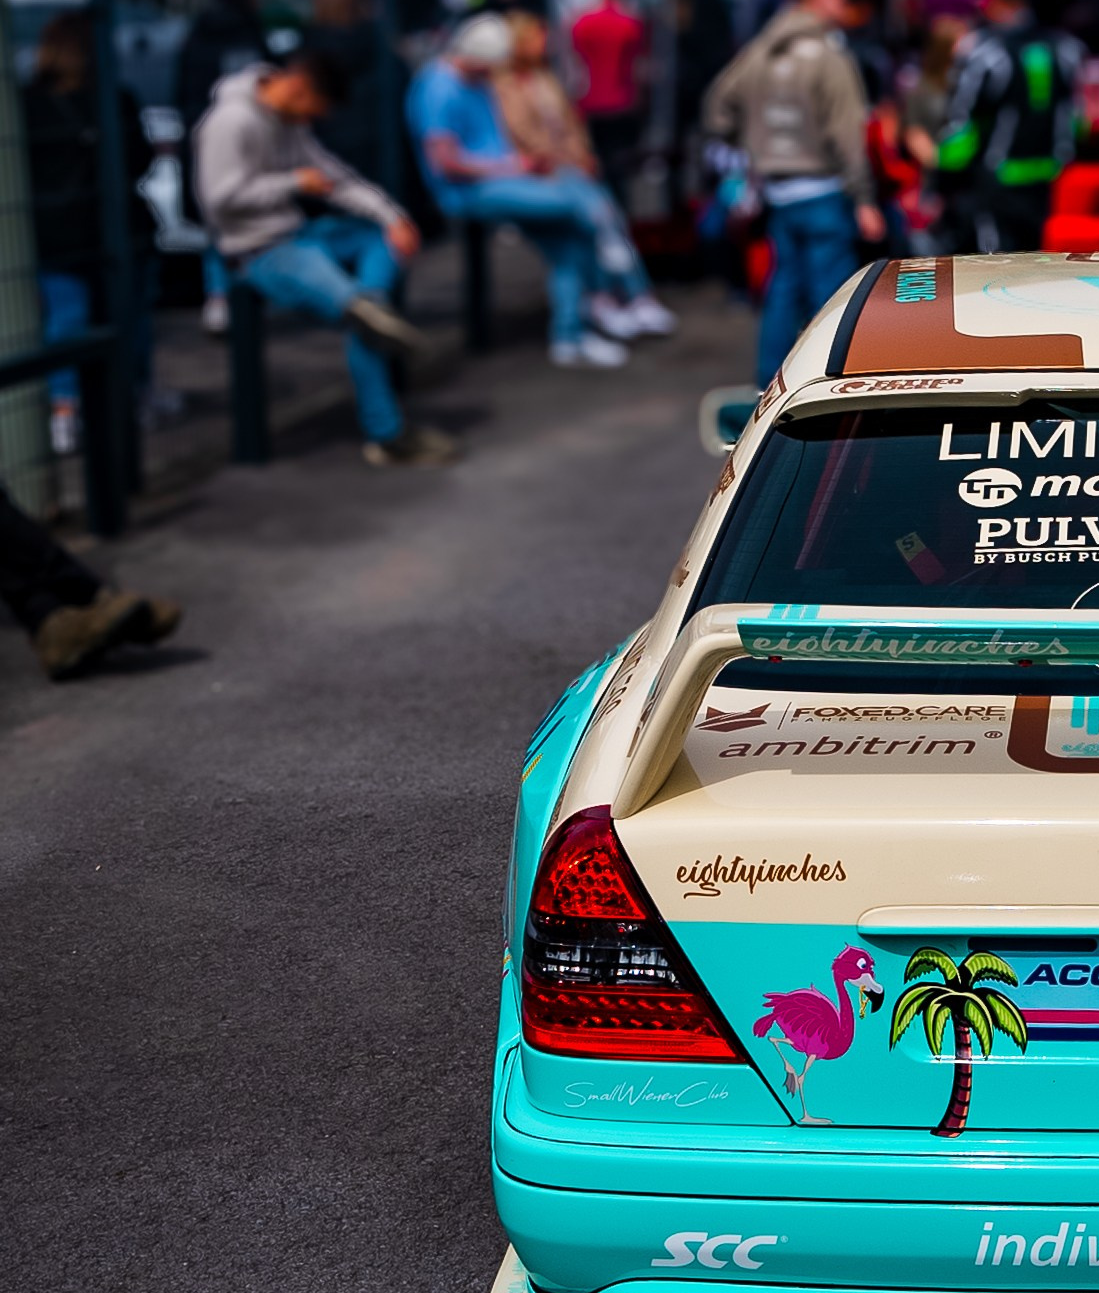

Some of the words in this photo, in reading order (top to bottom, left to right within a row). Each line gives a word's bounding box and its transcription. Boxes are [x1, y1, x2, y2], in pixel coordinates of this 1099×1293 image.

[974, 553, 999, 564] BY
[1004, 552, 1071, 563] BUSCH
[753, 627, 1070, 657] eightyinches
[793, 705, 1006, 718] FOXED.CARE
[676, 853, 847, 899] eightyinches
